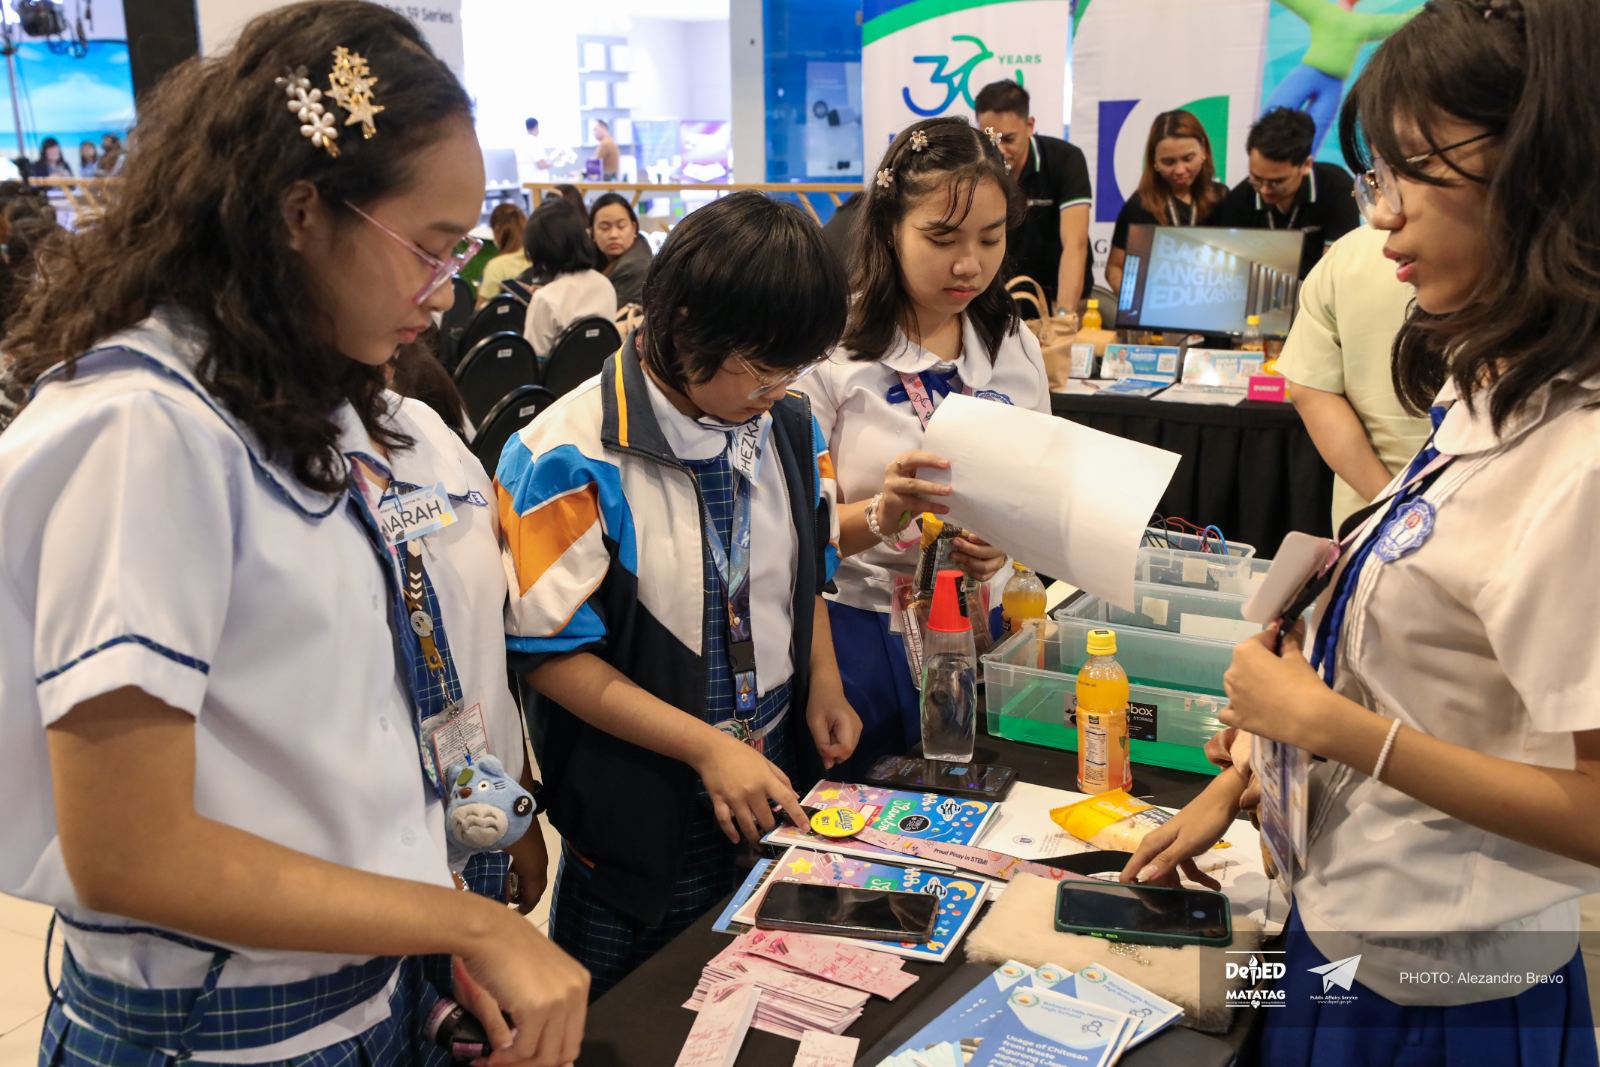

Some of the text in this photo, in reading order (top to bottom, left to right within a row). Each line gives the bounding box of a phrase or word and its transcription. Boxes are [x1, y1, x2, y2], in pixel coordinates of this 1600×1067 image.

[422, 7, 454, 24] Series
[998, 54, 1042, 65] YEARS
[1152, 260, 1205, 286] ANG
[740, 416, 762, 478] HEZKA
[933, 848, 949, 856] Proud
[949, 851, 964, 860] Pinay
[970, 856, 989, 866] STEM!
[1002, 1040, 1056, 1060] from Waste
[1006, 1034, 1034, 1047] Usage
[1047, 1045, 1088, 1061] Chitosan
